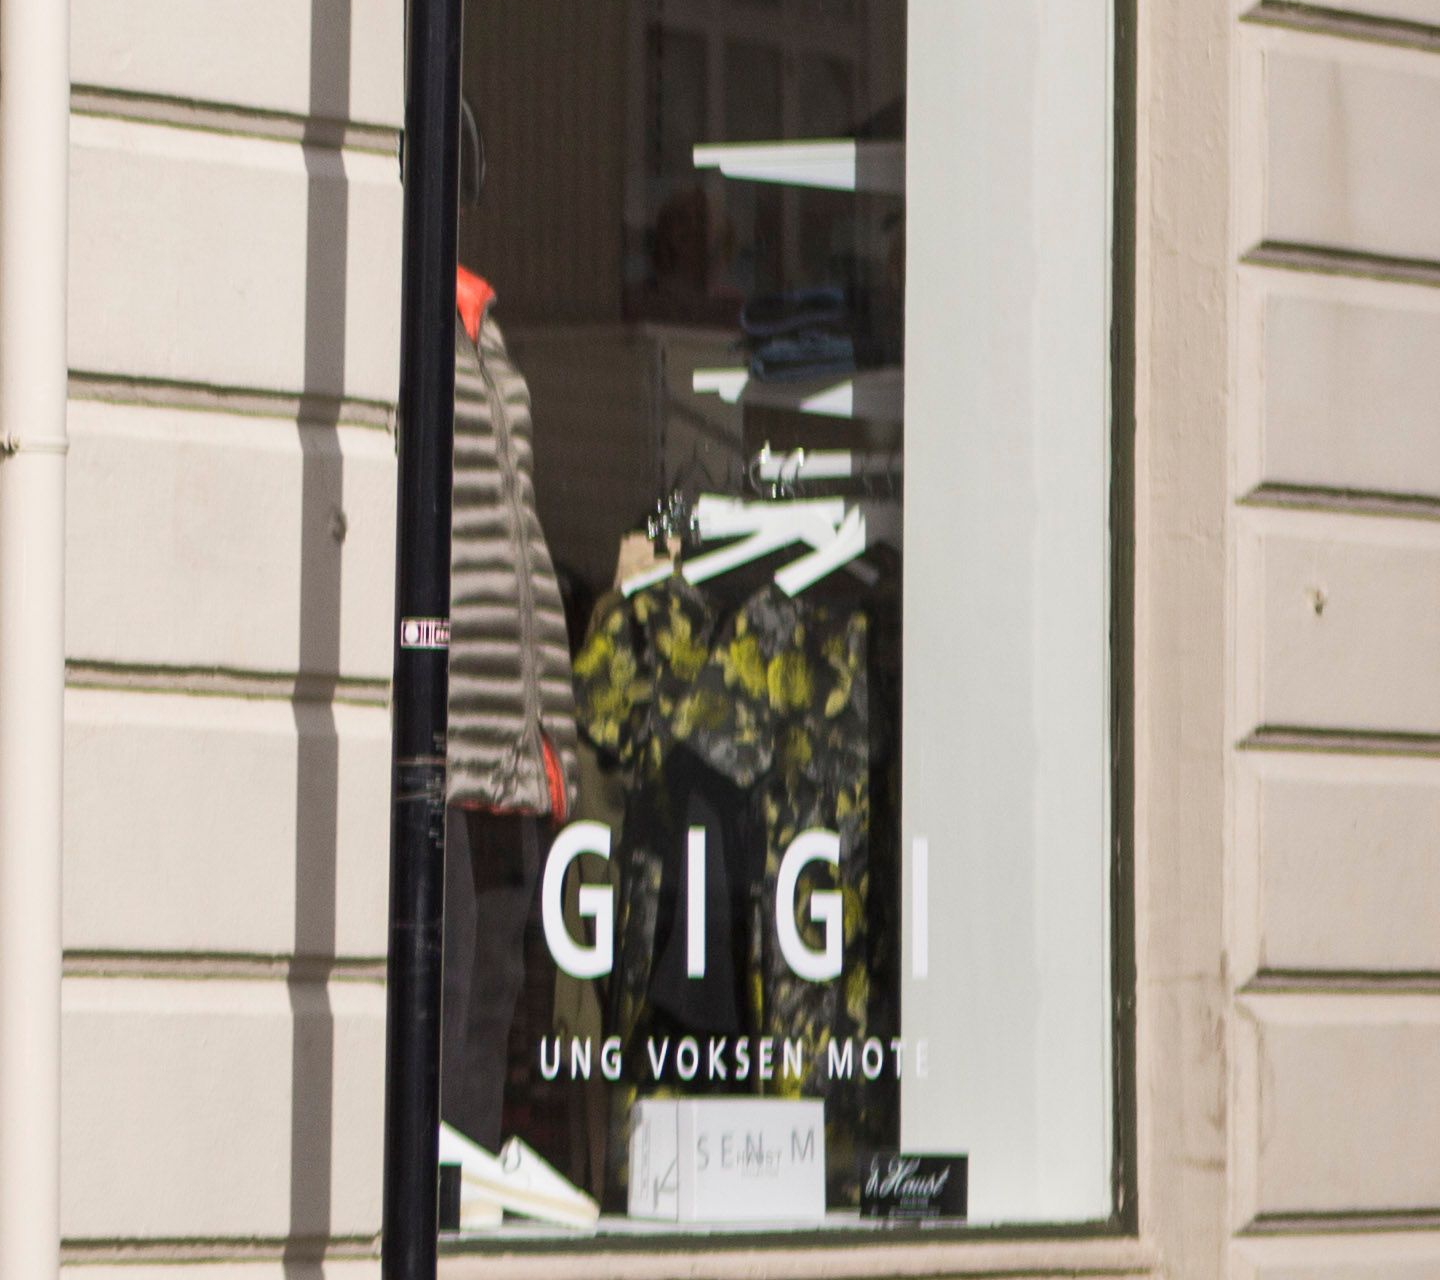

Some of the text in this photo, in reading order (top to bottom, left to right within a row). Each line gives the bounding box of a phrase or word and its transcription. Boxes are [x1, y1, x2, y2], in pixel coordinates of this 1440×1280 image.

[541, 819, 930, 982] GIGI
[539, 1035, 929, 1081] UNG VOKSEN MOTE
